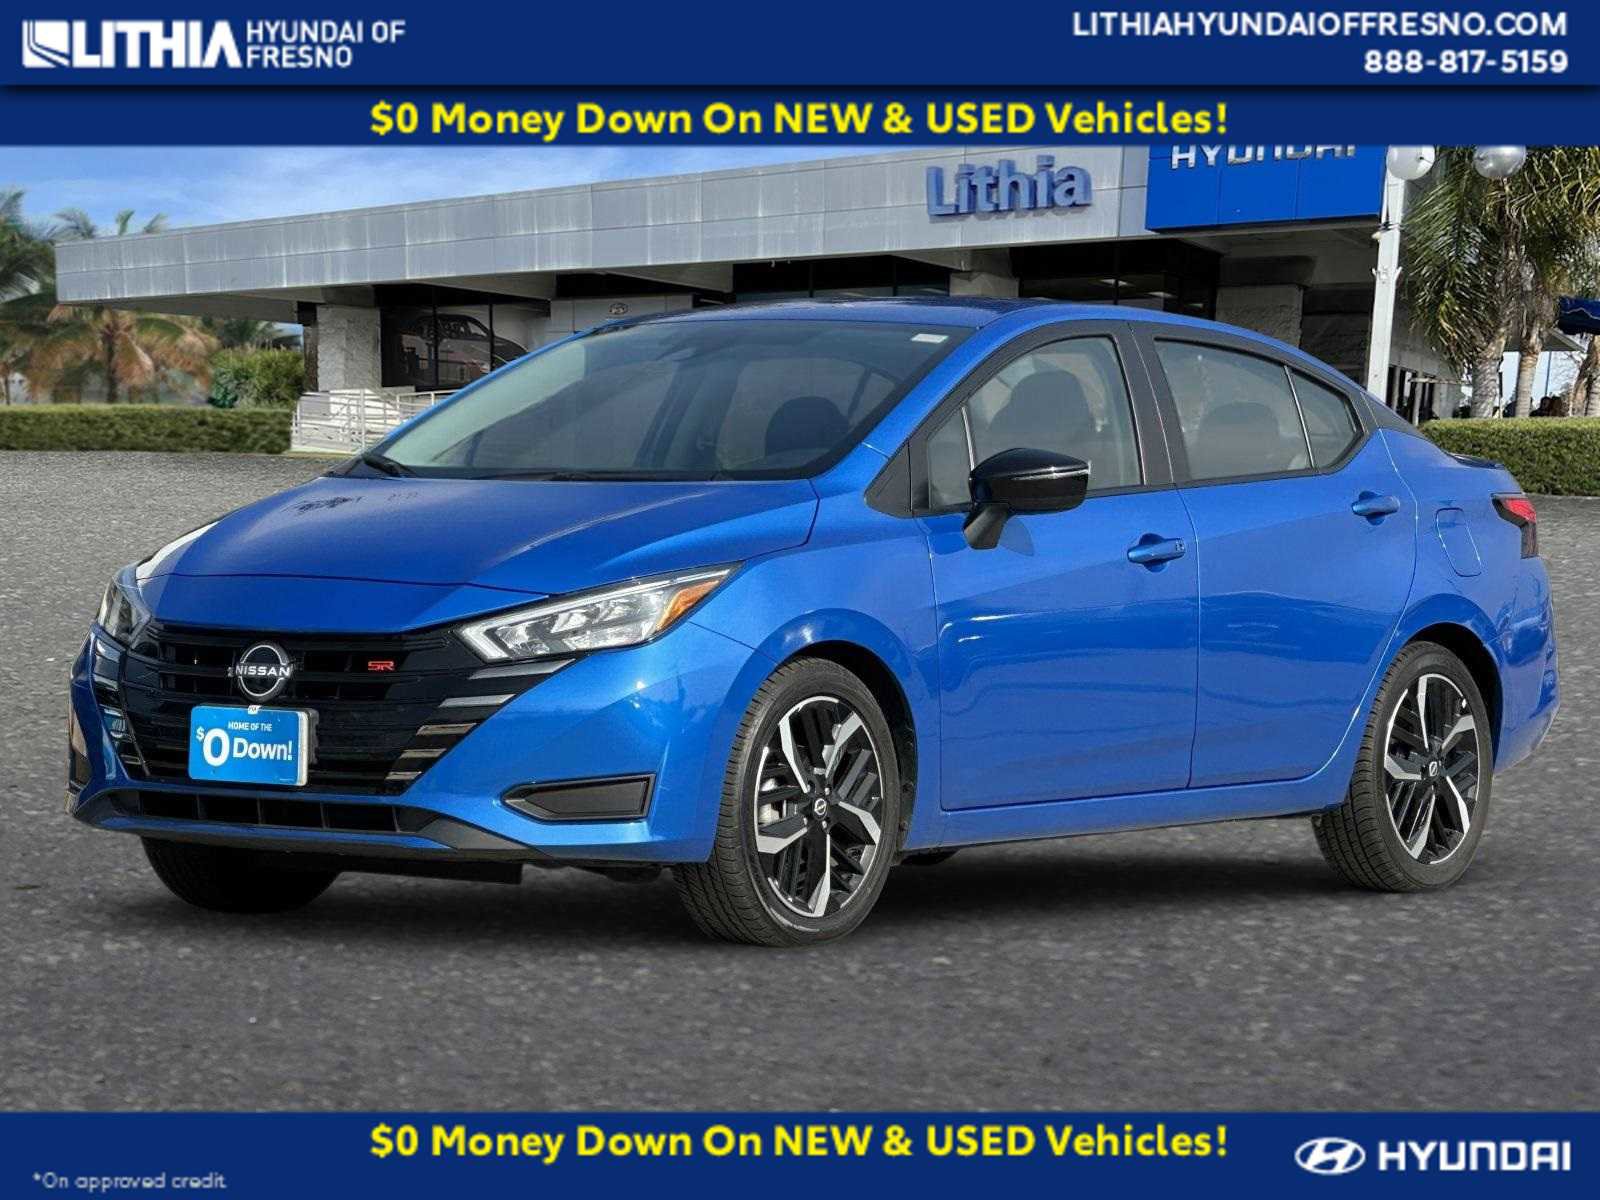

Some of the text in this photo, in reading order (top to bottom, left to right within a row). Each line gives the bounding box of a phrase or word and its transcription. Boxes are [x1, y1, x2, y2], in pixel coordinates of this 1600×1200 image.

[926, 155, 1092, 216] Lithia
[236, 664, 291, 677] NISSAN
[367, 660, 395, 671] SR
[228, 721, 272, 732] HOME OF THE
[233, 737, 293, 761] Down!
